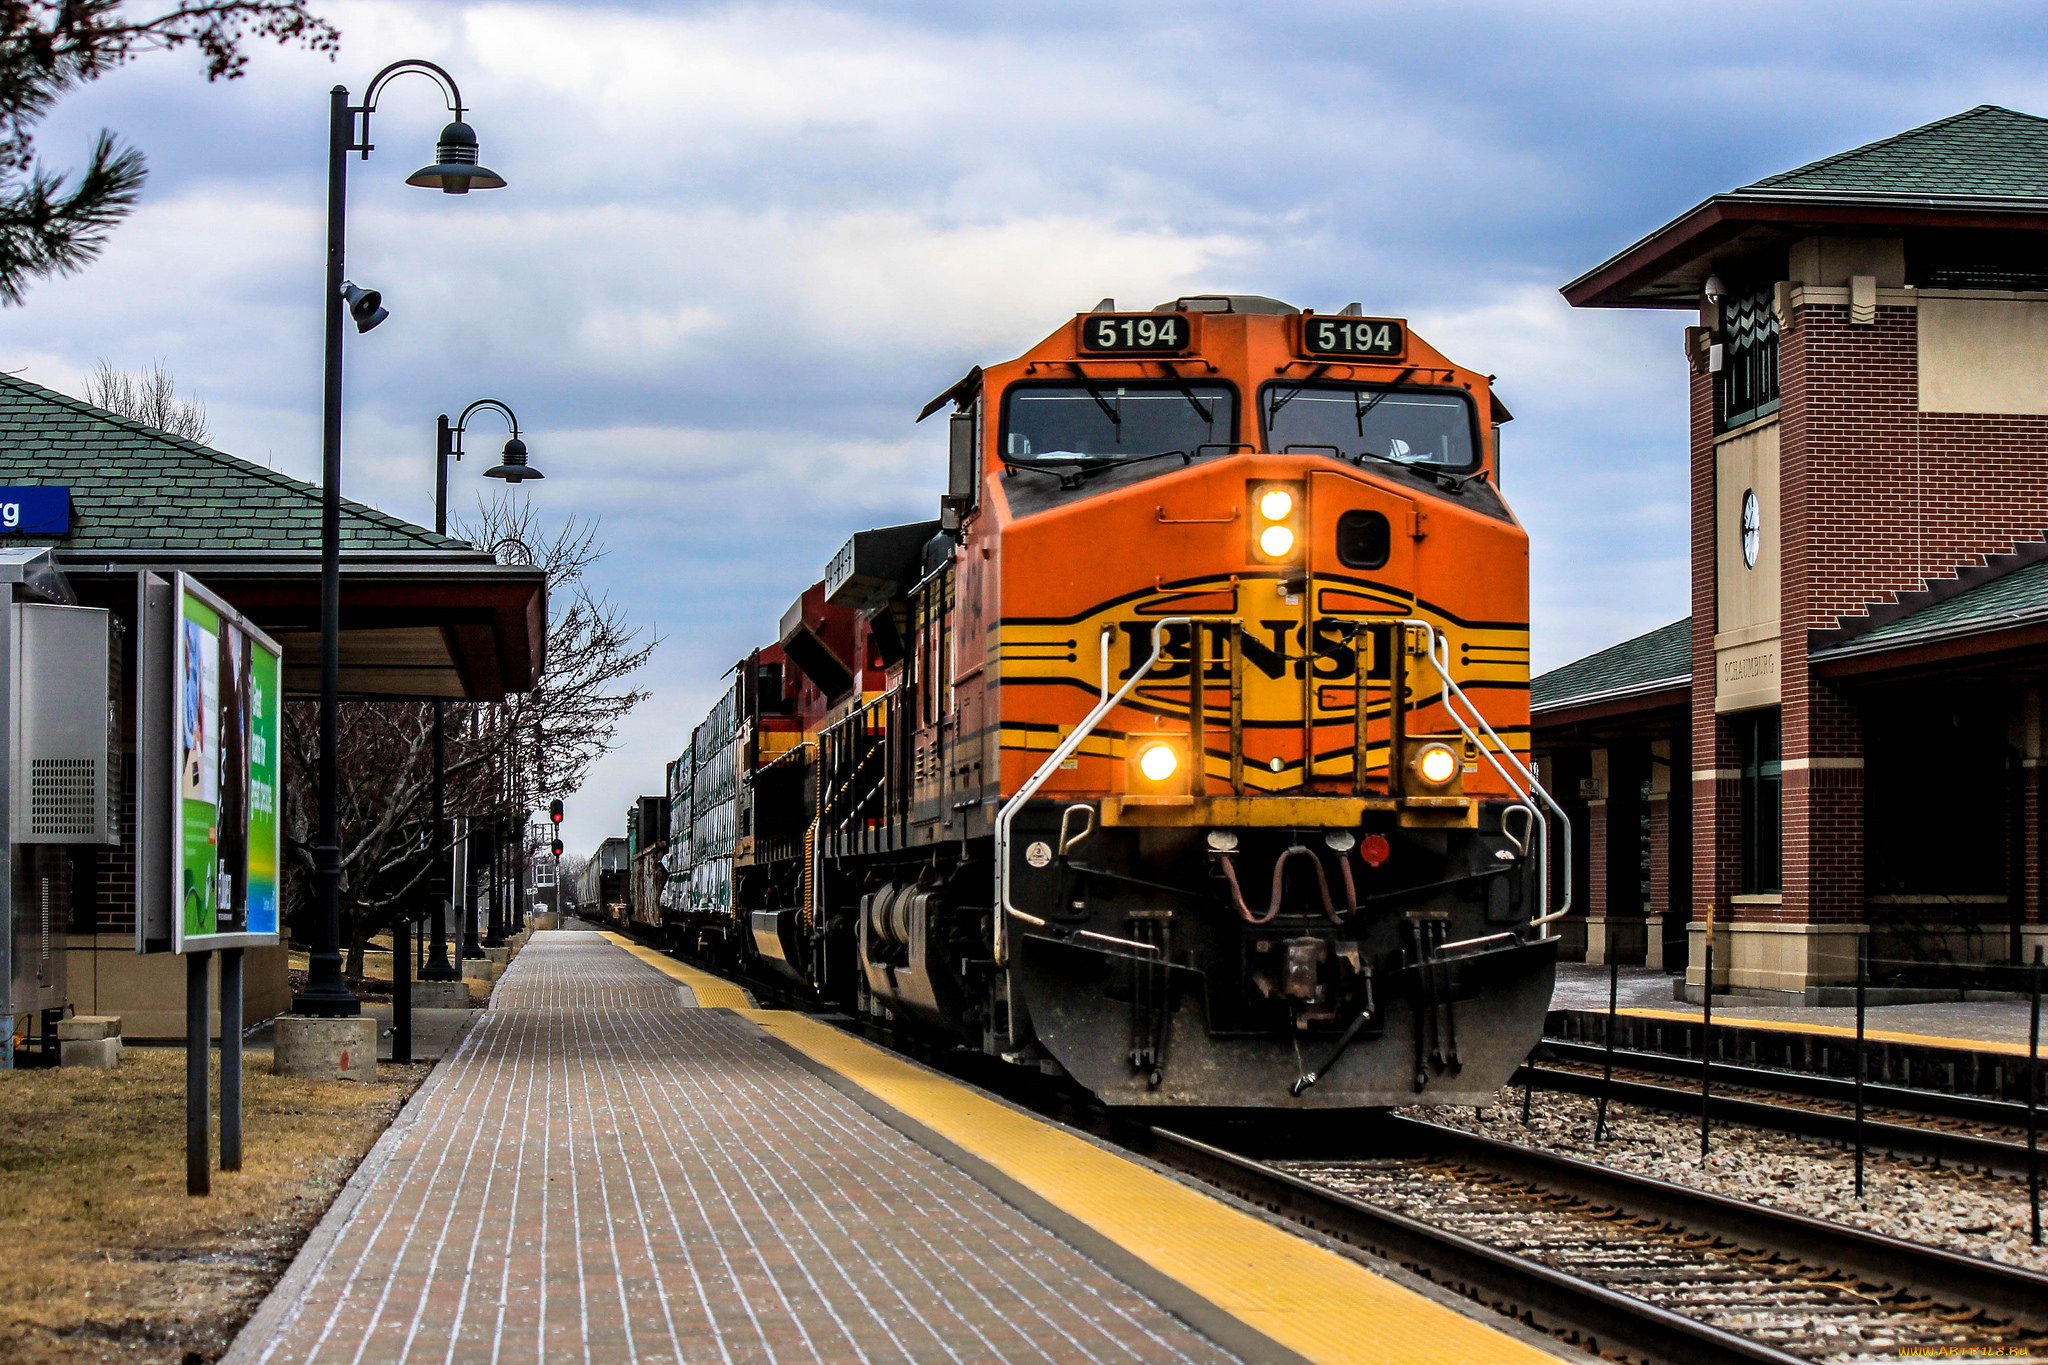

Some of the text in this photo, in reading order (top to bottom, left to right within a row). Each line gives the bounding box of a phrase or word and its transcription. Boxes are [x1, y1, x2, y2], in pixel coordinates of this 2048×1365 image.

[1097, 319, 1177, 347] 5194
[1317, 322, 1392, 351] 5194
[0, 502, 19, 527] g
[1724, 653, 1774, 681] SCHAUMBURG
